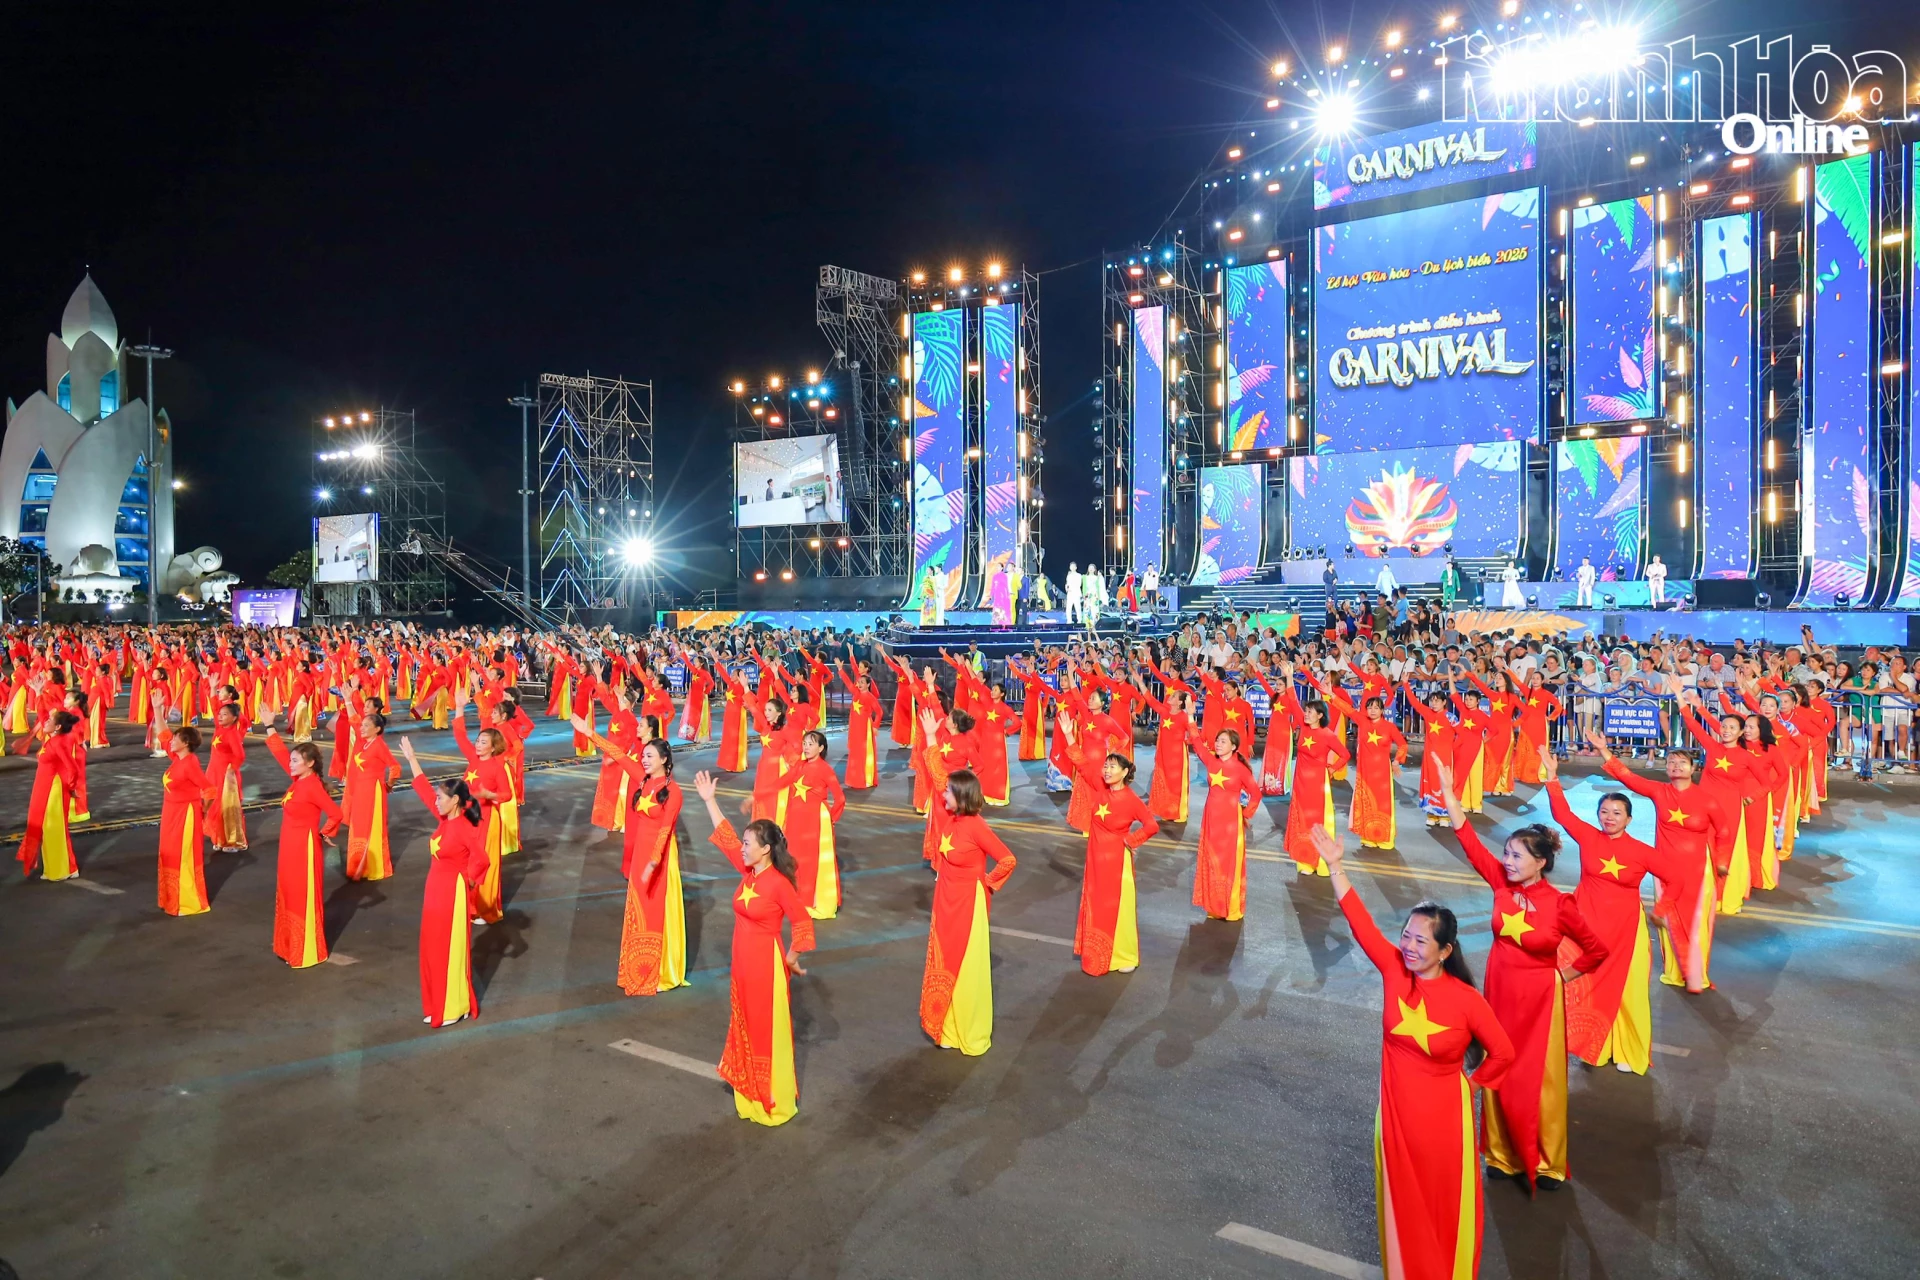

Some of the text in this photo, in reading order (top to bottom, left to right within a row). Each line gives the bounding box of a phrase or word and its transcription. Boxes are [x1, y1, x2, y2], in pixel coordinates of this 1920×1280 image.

[1347, 127, 1507, 184] CARNIVAL
[1342, 274, 1359, 288] hội
[1420, 261, 1441, 275] Du
[1442, 257, 1464, 274] lịch
[1466, 252, 1492, 269] biển
[1494, 245, 1529, 264] 2025
[1329, 328, 1535, 387] CARNIVAL
[1625, 709, 1637, 718] VỰC
[1638, 709, 1652, 718] CẤM
